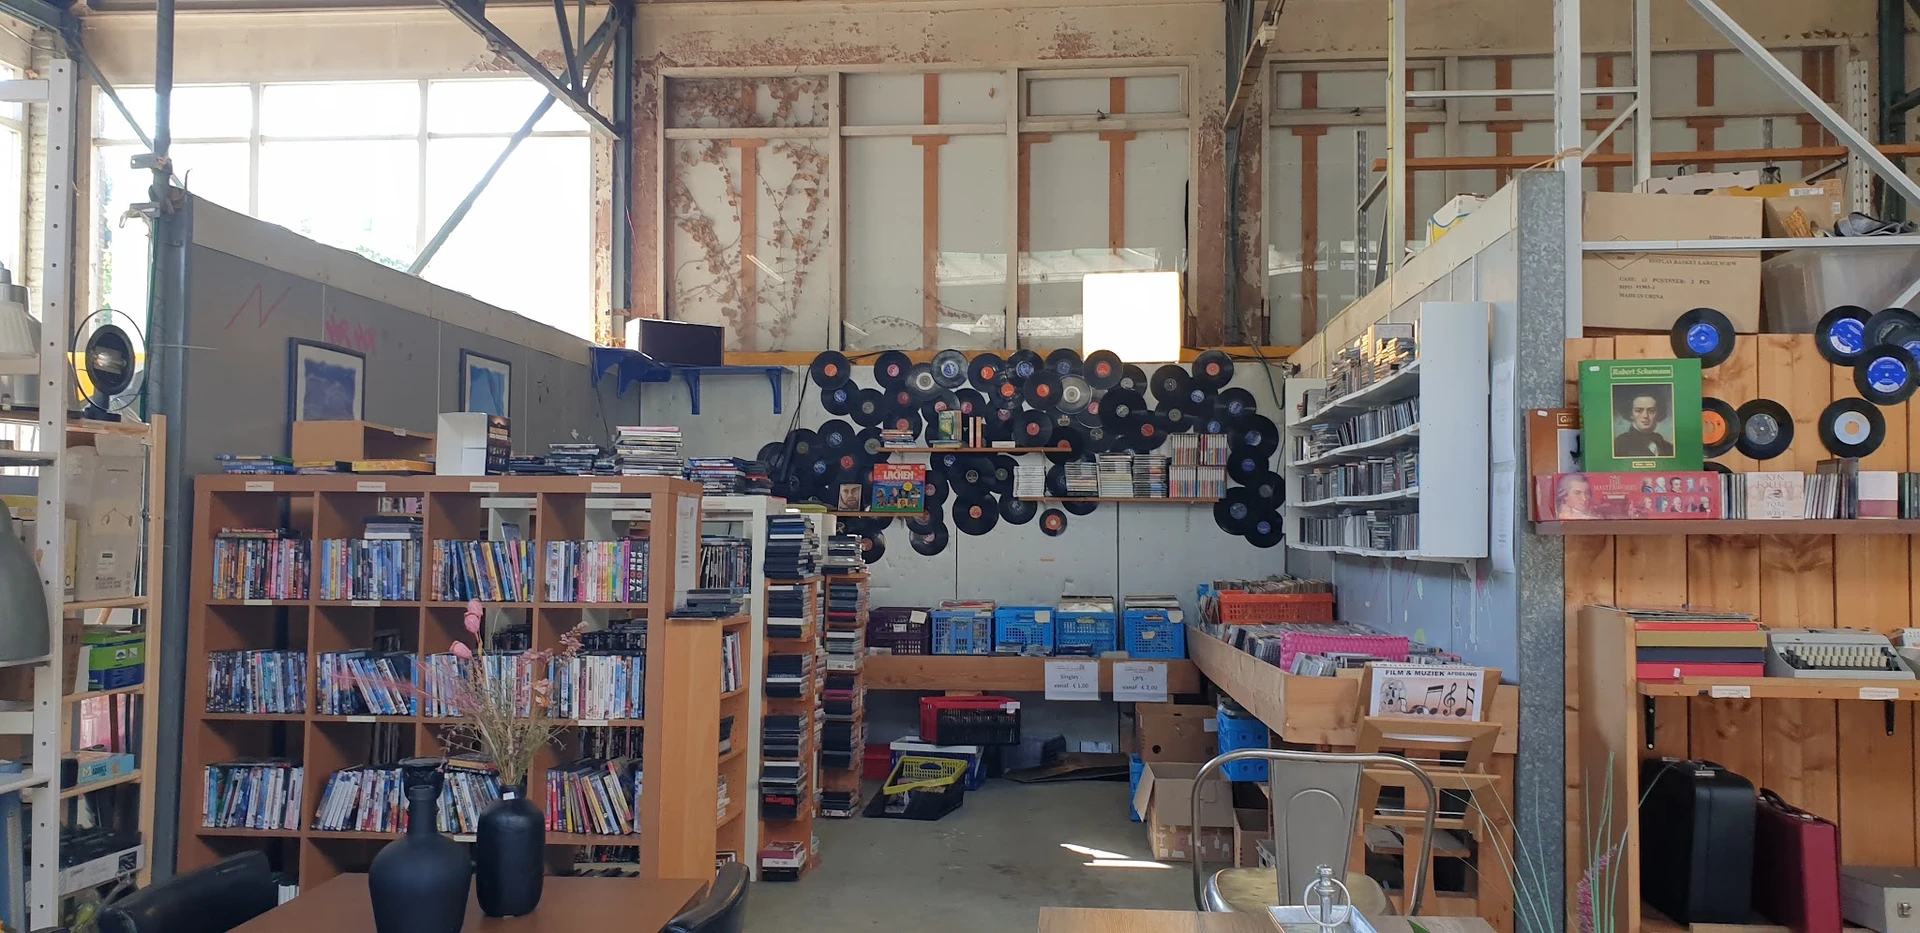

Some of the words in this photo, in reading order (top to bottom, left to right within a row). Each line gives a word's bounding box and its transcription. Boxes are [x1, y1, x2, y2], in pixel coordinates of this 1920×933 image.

[1612, 367, 1636, 376] Robert
[1636, 367, 1672, 376] Schumann
[883, 470, 914, 480] LACHEN
[629, 551, 637, 592] PENOZA
